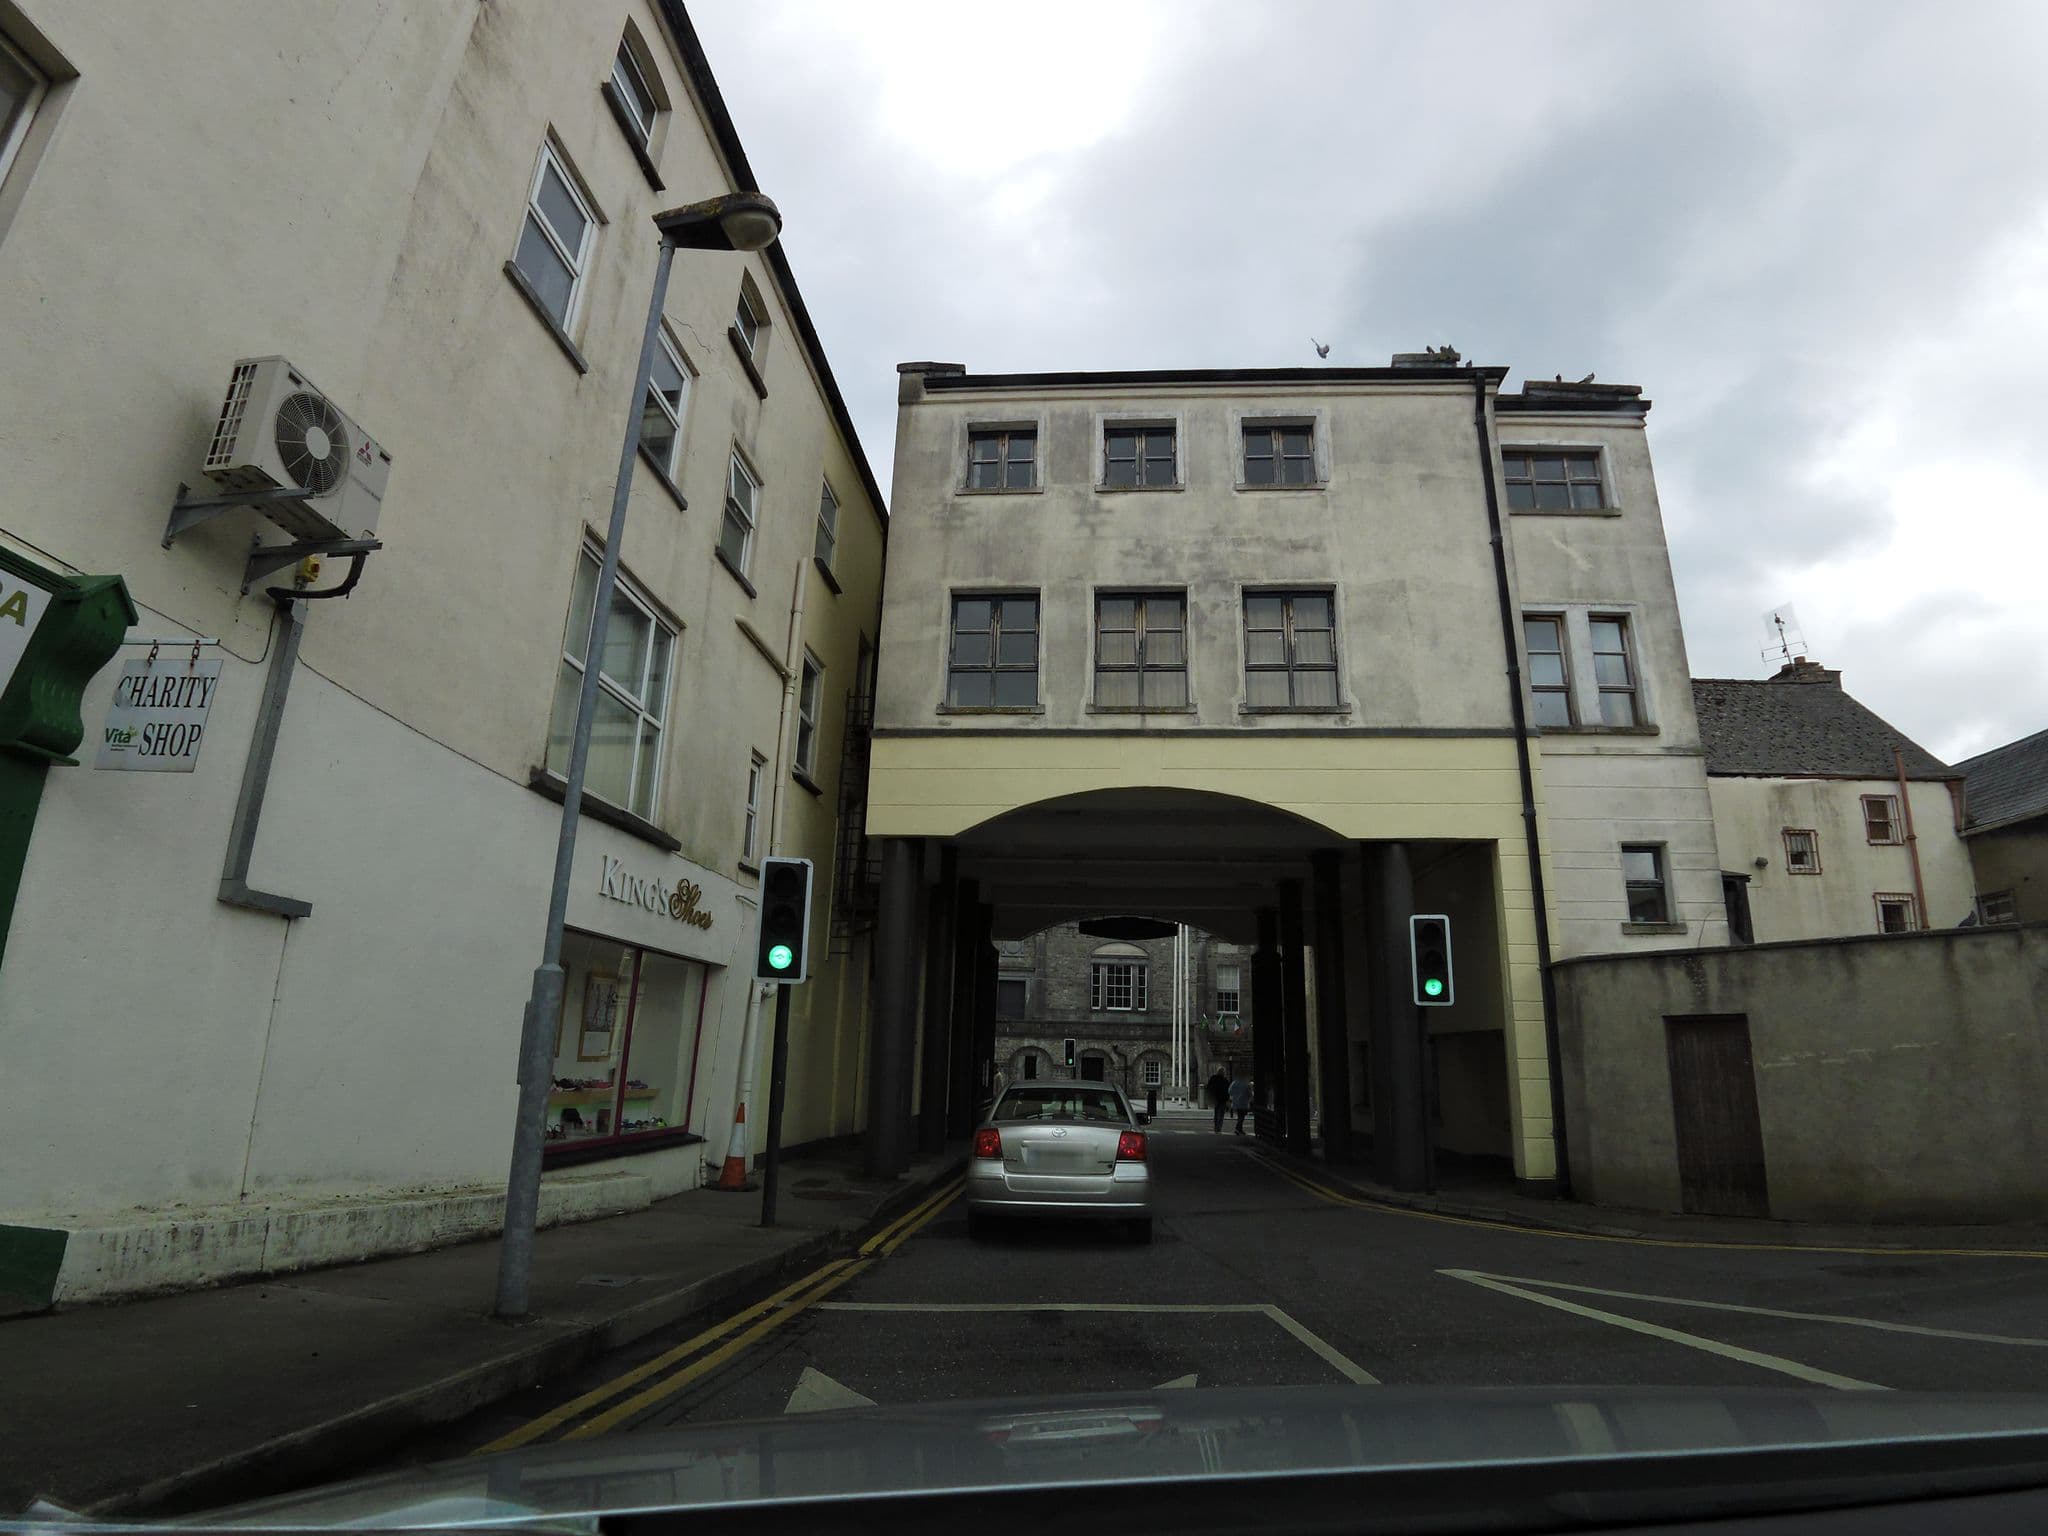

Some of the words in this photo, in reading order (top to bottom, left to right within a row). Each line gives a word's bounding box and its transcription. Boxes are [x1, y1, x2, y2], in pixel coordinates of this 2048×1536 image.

[0, 580, 28, 627] A
[115, 675, 216, 708] CHARITY
[105, 727, 132, 744] Vita
[138, 722, 202, 757] SHOP
[598, 855, 670, 916] KING'S
[669, 878, 713, 930] Shoes
